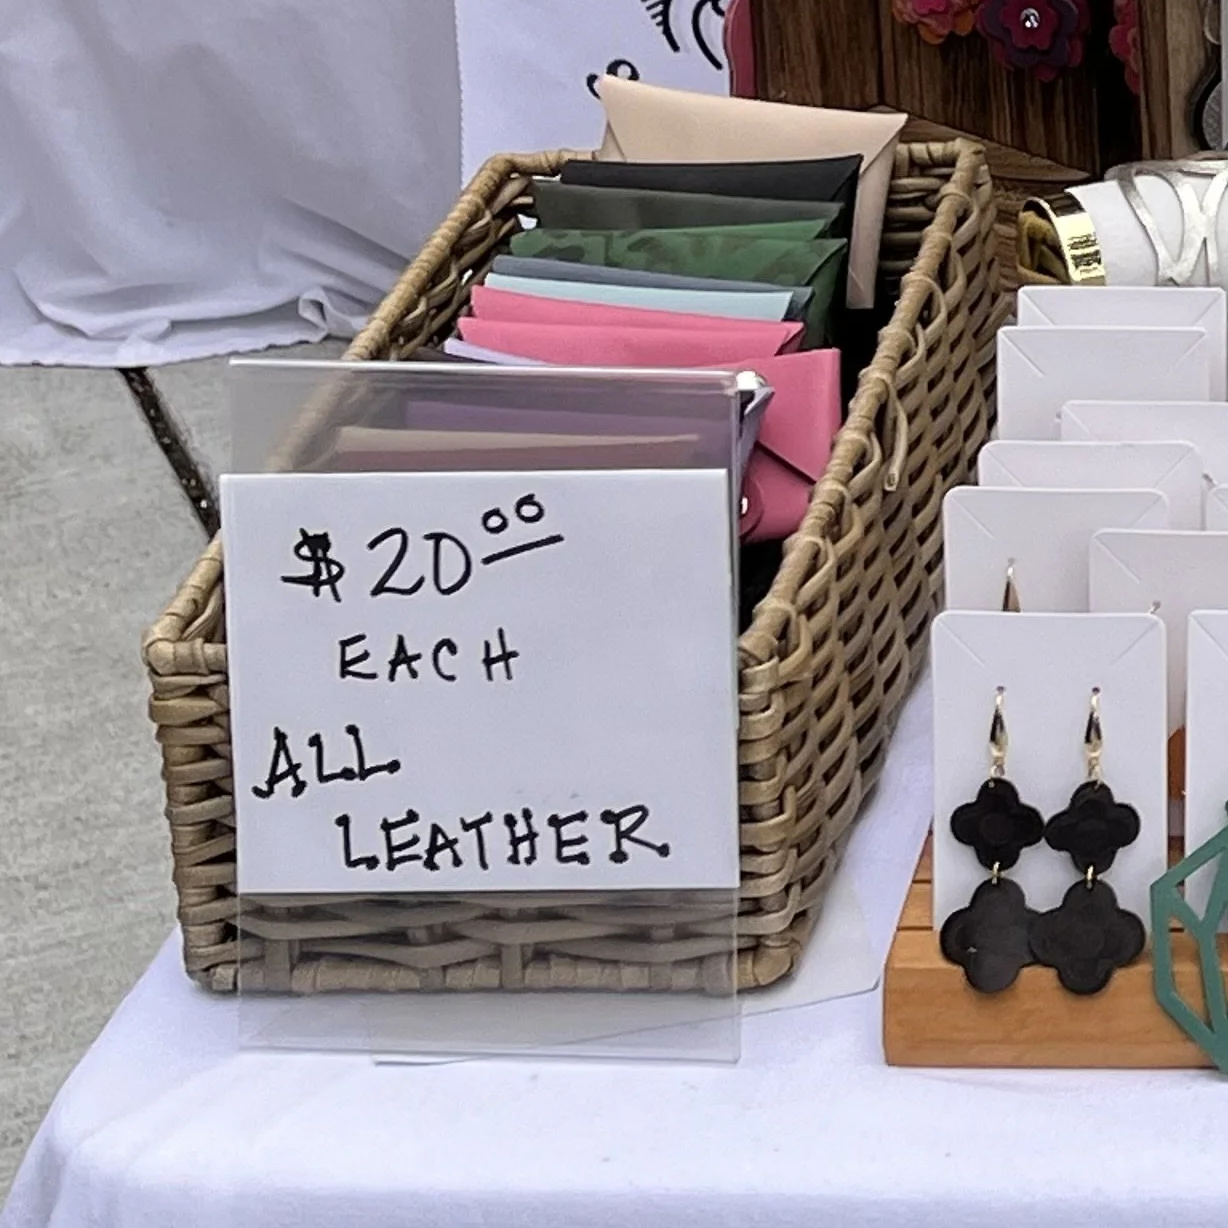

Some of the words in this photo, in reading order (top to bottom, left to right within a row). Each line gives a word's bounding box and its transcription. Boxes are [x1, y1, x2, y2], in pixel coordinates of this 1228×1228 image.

[338, 626, 520, 682] EACH
[251, 723, 401, 800] ALL
[334, 804, 671, 872] LEATHER
